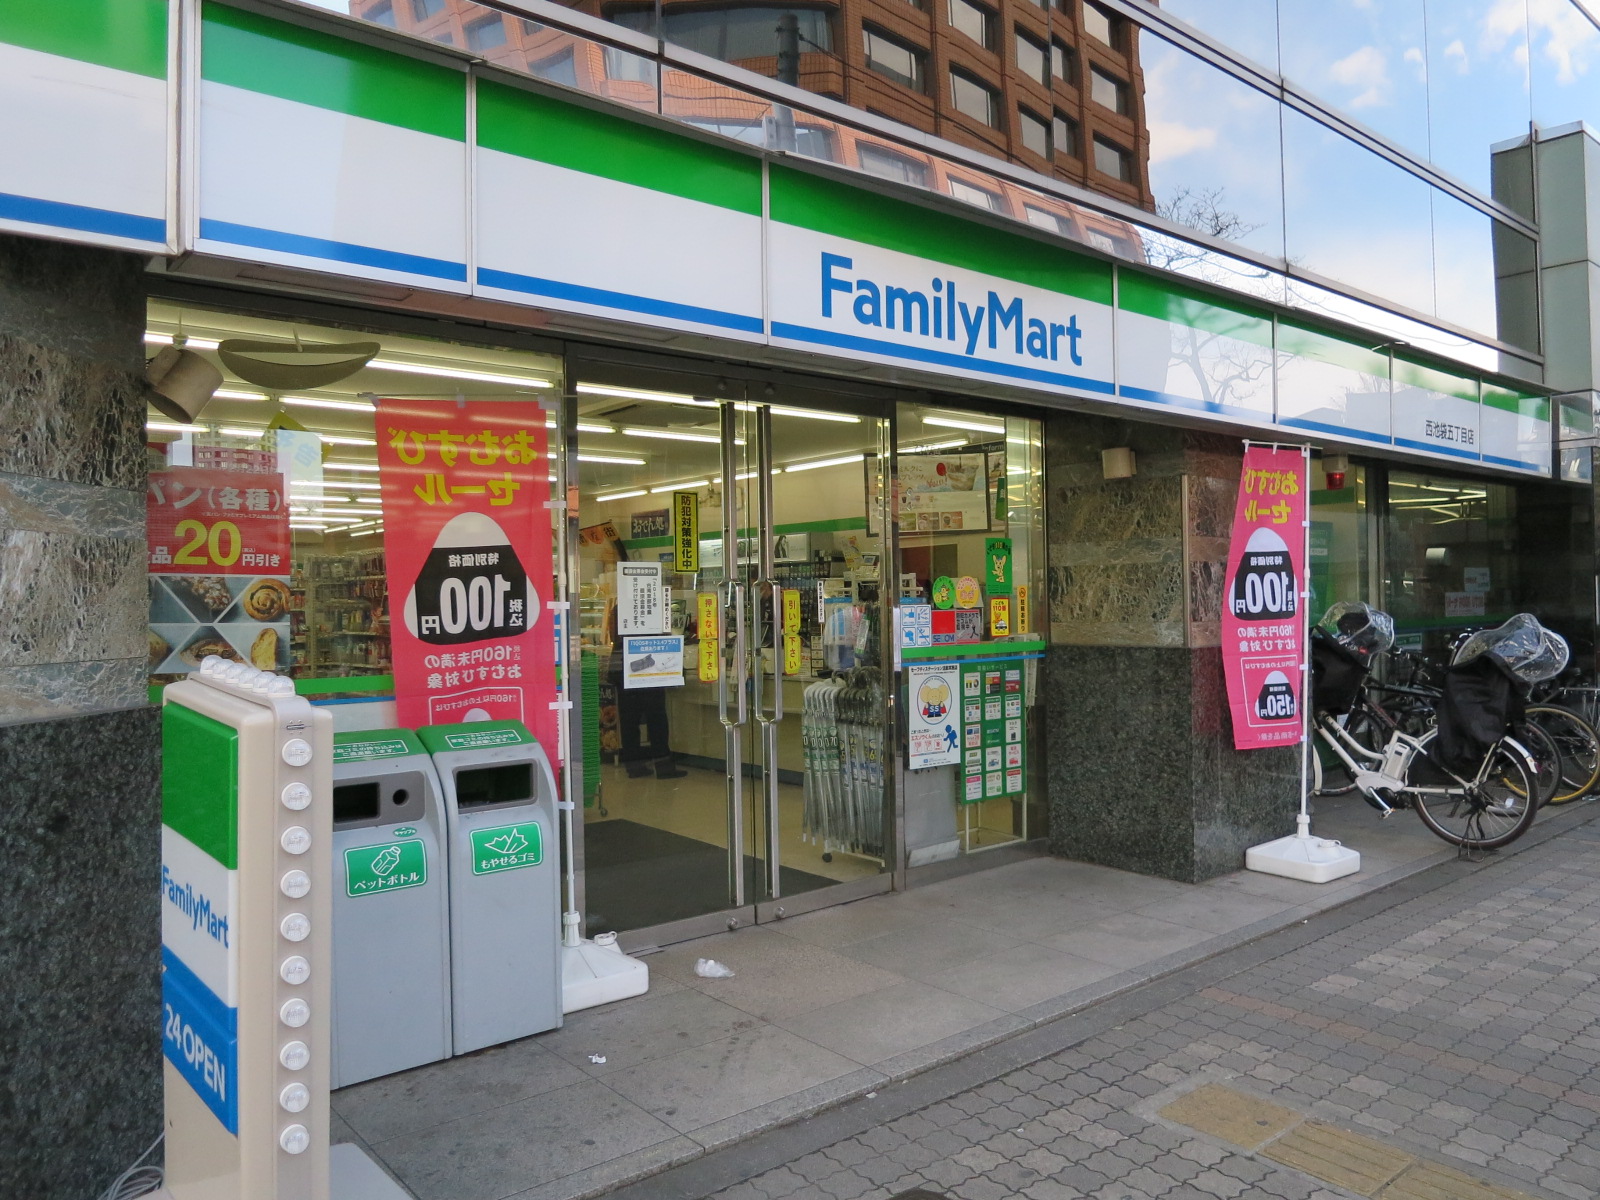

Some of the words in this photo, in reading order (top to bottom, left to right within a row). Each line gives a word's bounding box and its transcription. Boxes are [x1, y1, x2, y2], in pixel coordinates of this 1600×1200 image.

[821, 251, 1082, 366] FamilyMart
[1425, 419, 1474, 445] 西池袋五丁目店
[173, 519, 242, 567] 20
[681, 495, 692, 570] 防犯対策強化中
[704, 598, 714, 680] 押さないで下さい
[788, 600, 797, 669] 引いて下さい
[933, 634, 955, 643] SEOM
[354, 871, 420, 890] ペットボトル
[481, 853, 535, 869] もやせるゴミ
[162, 864, 229, 949] FamilyMart
